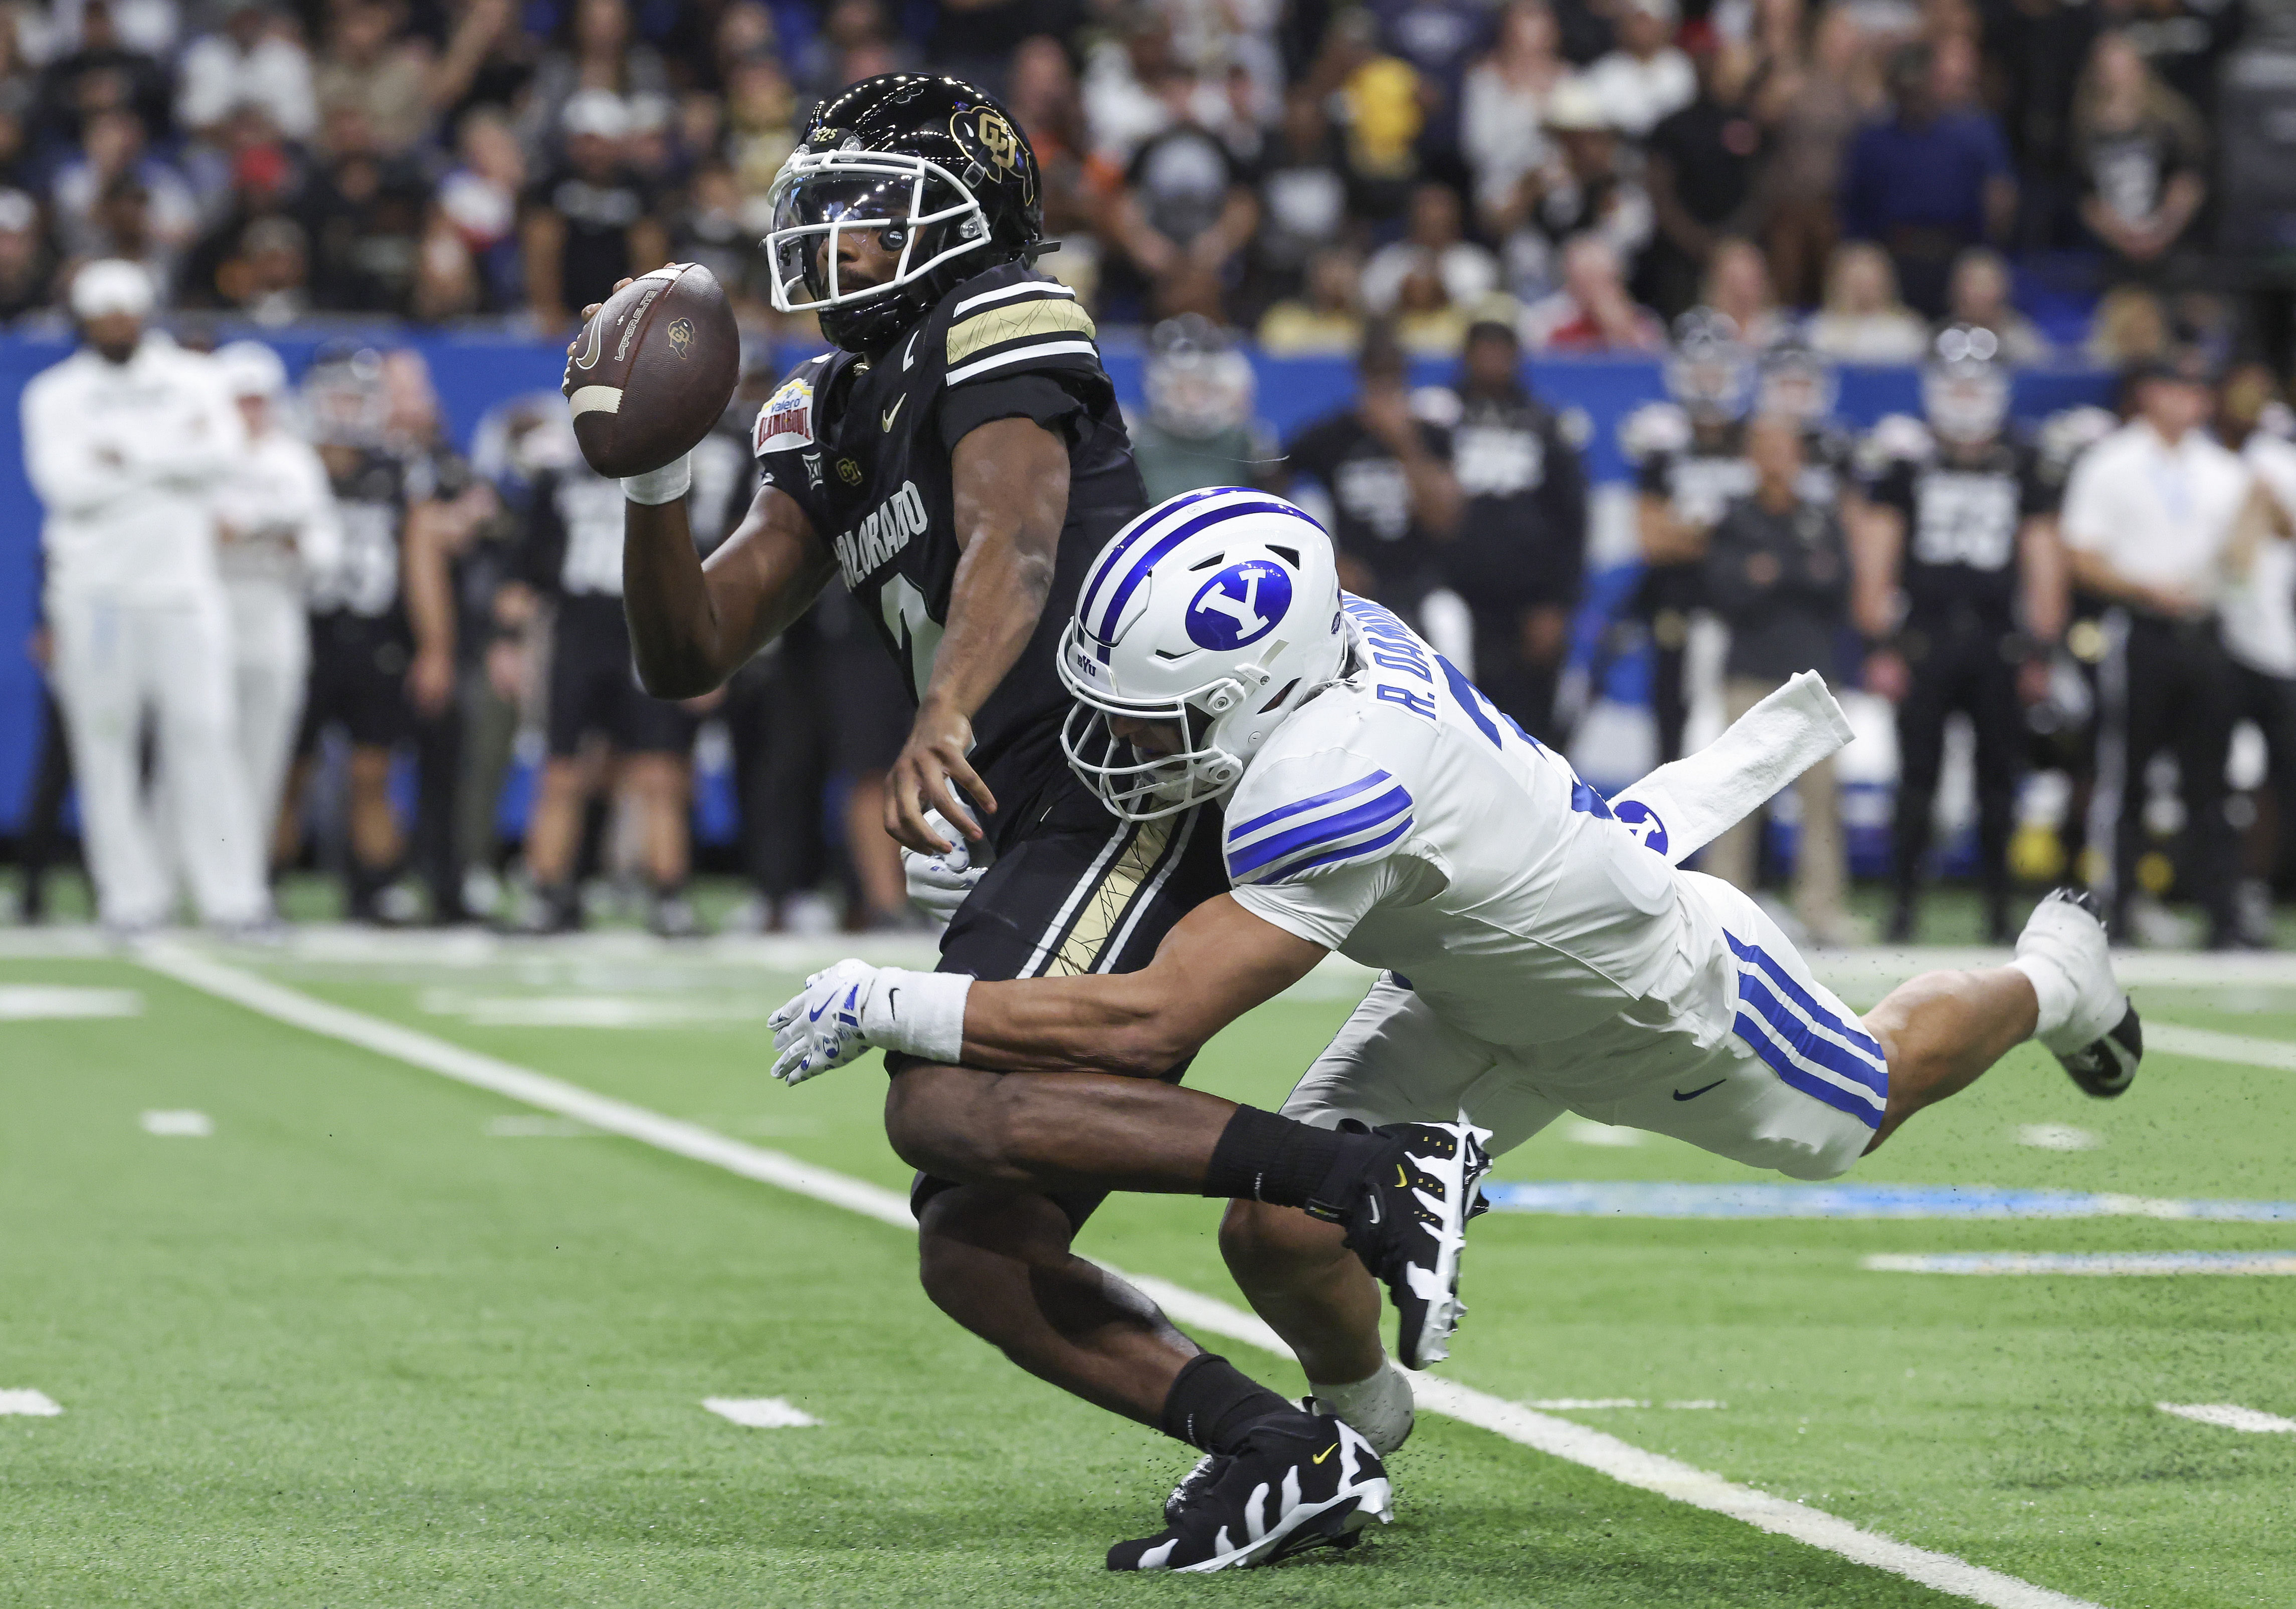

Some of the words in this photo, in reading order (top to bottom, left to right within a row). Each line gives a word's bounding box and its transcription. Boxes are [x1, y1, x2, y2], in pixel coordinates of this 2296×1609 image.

[614, 318, 640, 361] VAPOR
[633, 290, 658, 319] ELITE
[771, 398, 801, 413] Valero
[1195, 568, 1270, 640] Y
[1077, 654, 1096, 677] BYU
[1377, 684, 1436, 720] R.
